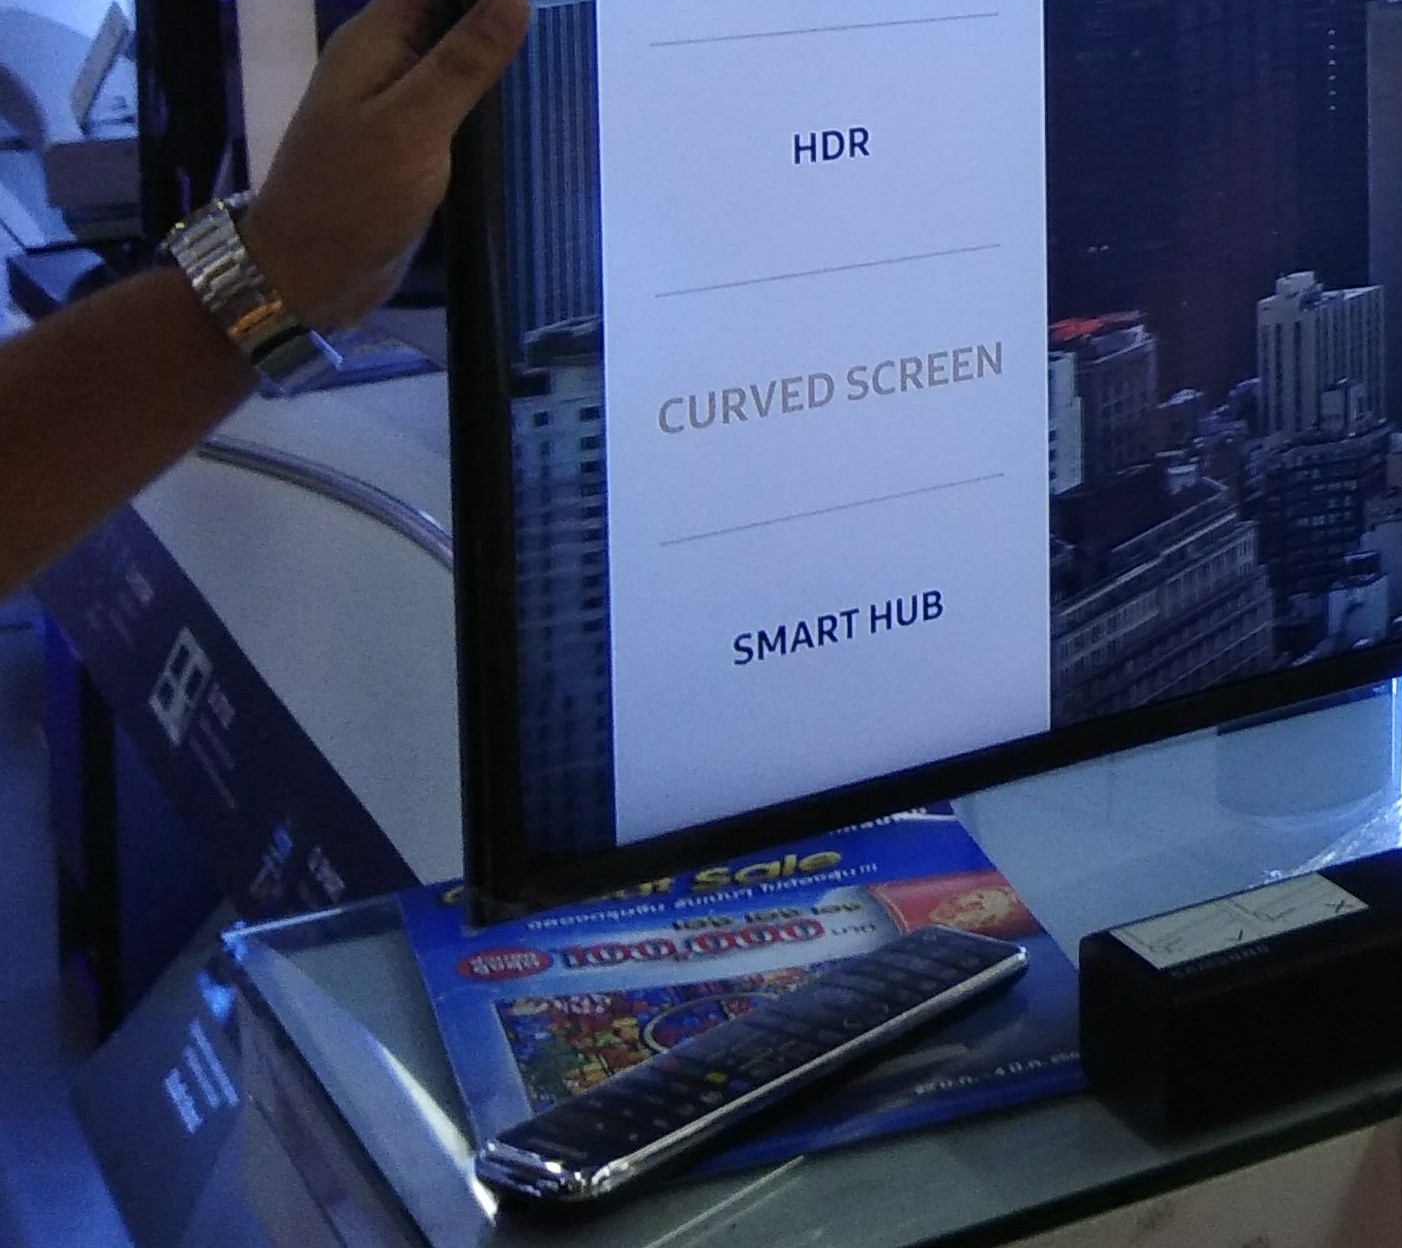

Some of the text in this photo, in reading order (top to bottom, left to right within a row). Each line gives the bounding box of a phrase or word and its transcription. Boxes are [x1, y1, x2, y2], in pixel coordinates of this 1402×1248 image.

[792, 126, 871, 165] HDR
[657, 340, 1004, 435] CURVED SCREEN
[733, 589, 944, 666] SMART HUB
[690, 850, 843, 891] Sale
